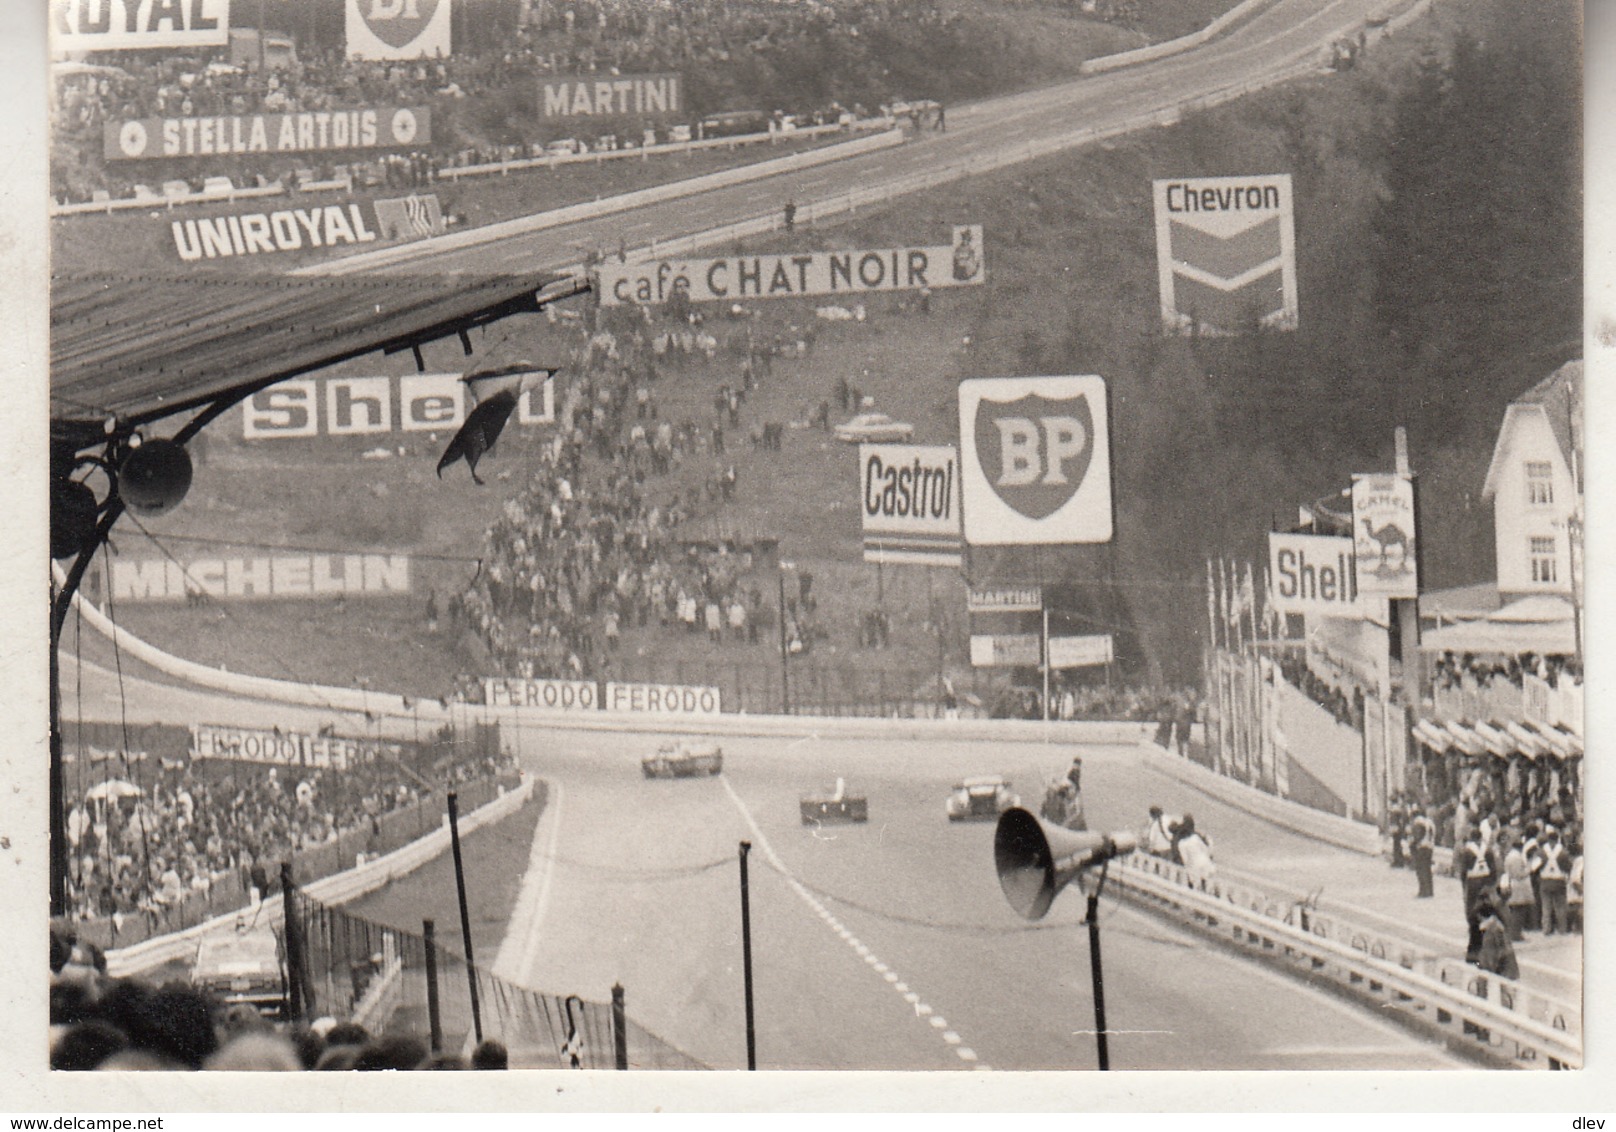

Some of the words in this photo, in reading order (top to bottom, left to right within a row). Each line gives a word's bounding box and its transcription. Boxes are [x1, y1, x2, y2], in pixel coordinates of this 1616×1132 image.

[544, 78, 678, 117] MARTINI
[163, 116, 268, 156] STELLA
[277, 110, 377, 151] ARTOIS
[1166, 183, 1280, 213] Chevron
[172, 203, 376, 261] UNIROYAL
[613, 262, 691, 302] café
[706, 255, 813, 297] CHAT
[830, 250, 931, 291] NOIR
[251, 384, 546, 432] Shel
[993, 416, 1086, 486] BP
[865, 454, 953, 520] Castrol
[1356, 493, 1409, 511] CAMEL
[113, 554, 409, 599] MICHELIN
[1278, 547, 1356, 603] Shell
[492, 681, 593, 709] FERODO
[613, 685, 715, 713] FERODO
